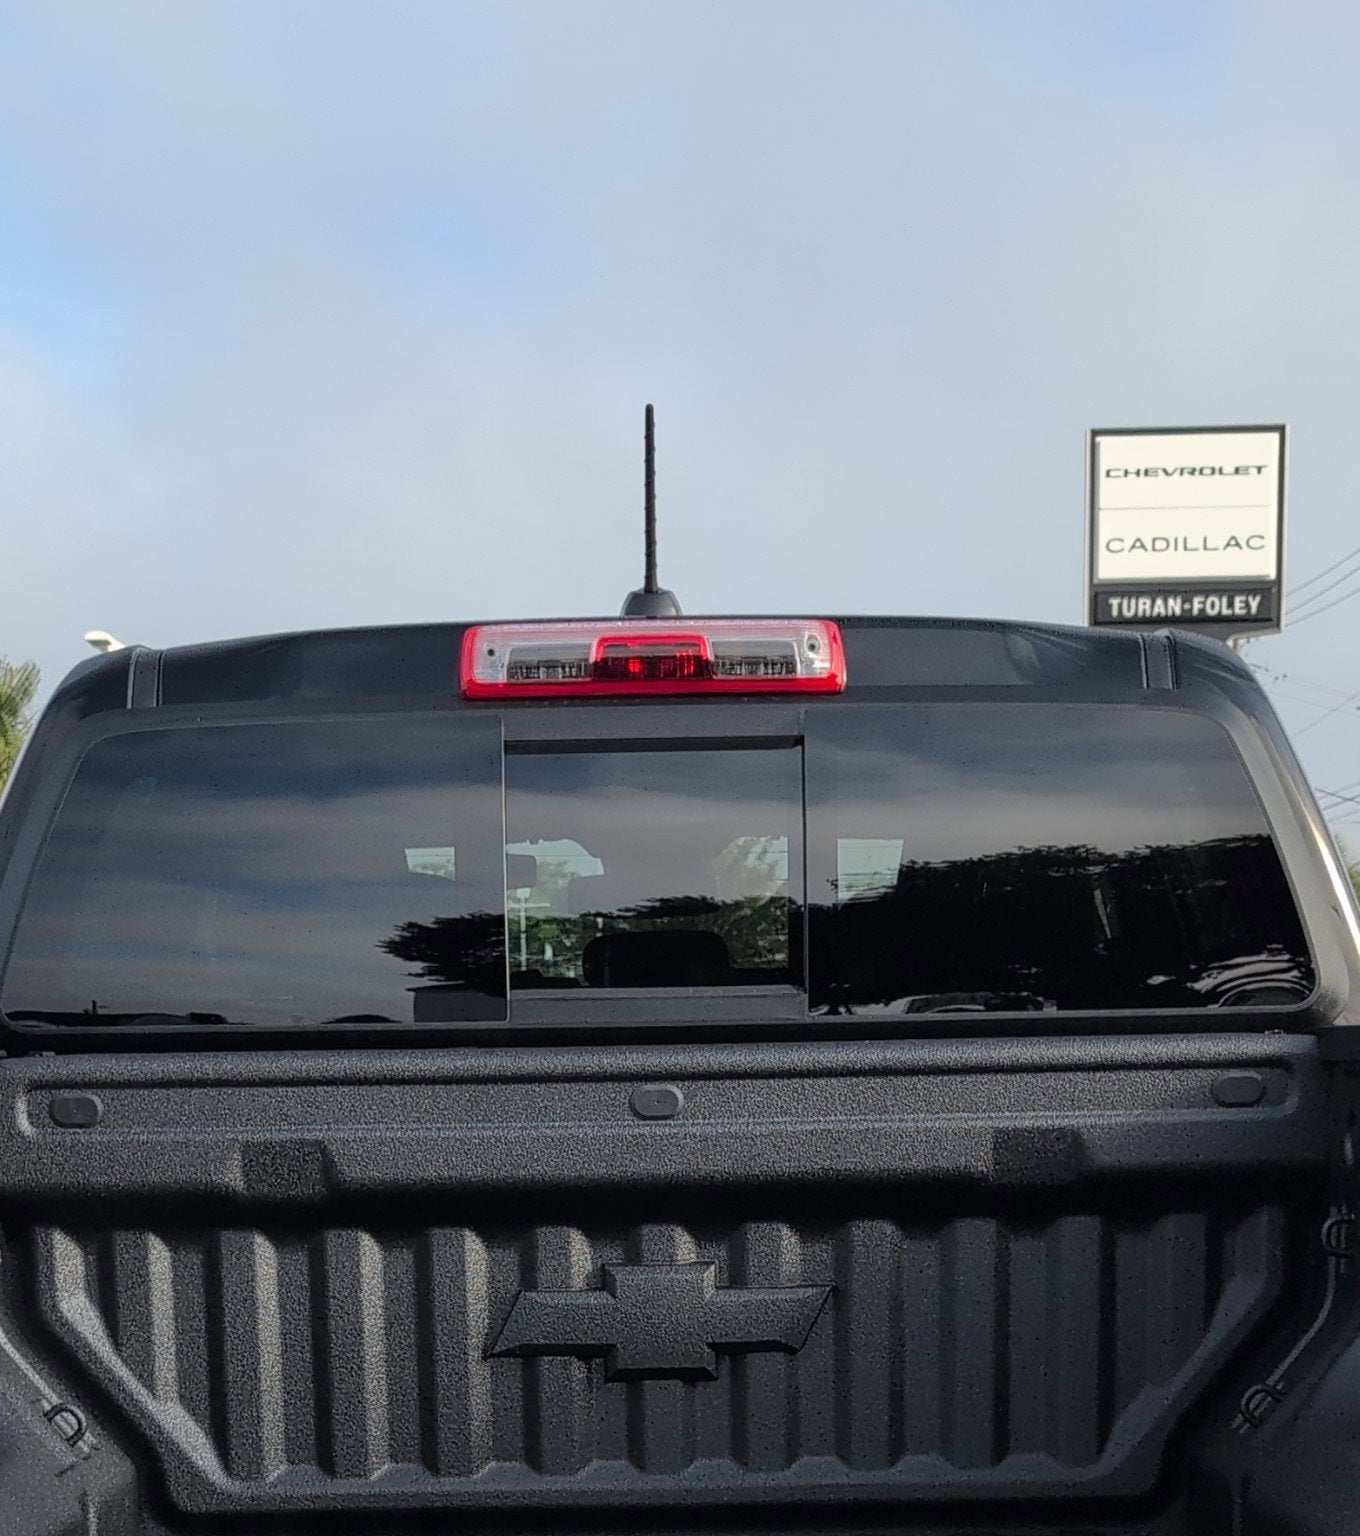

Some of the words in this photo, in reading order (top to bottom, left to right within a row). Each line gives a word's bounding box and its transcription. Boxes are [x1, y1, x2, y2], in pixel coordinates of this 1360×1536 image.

[1104, 465, 1268, 478] CHEVROLET
[1104, 534, 1266, 554] CADILLAC
[1108, 594, 1262, 619] TURAN-FOLEY
